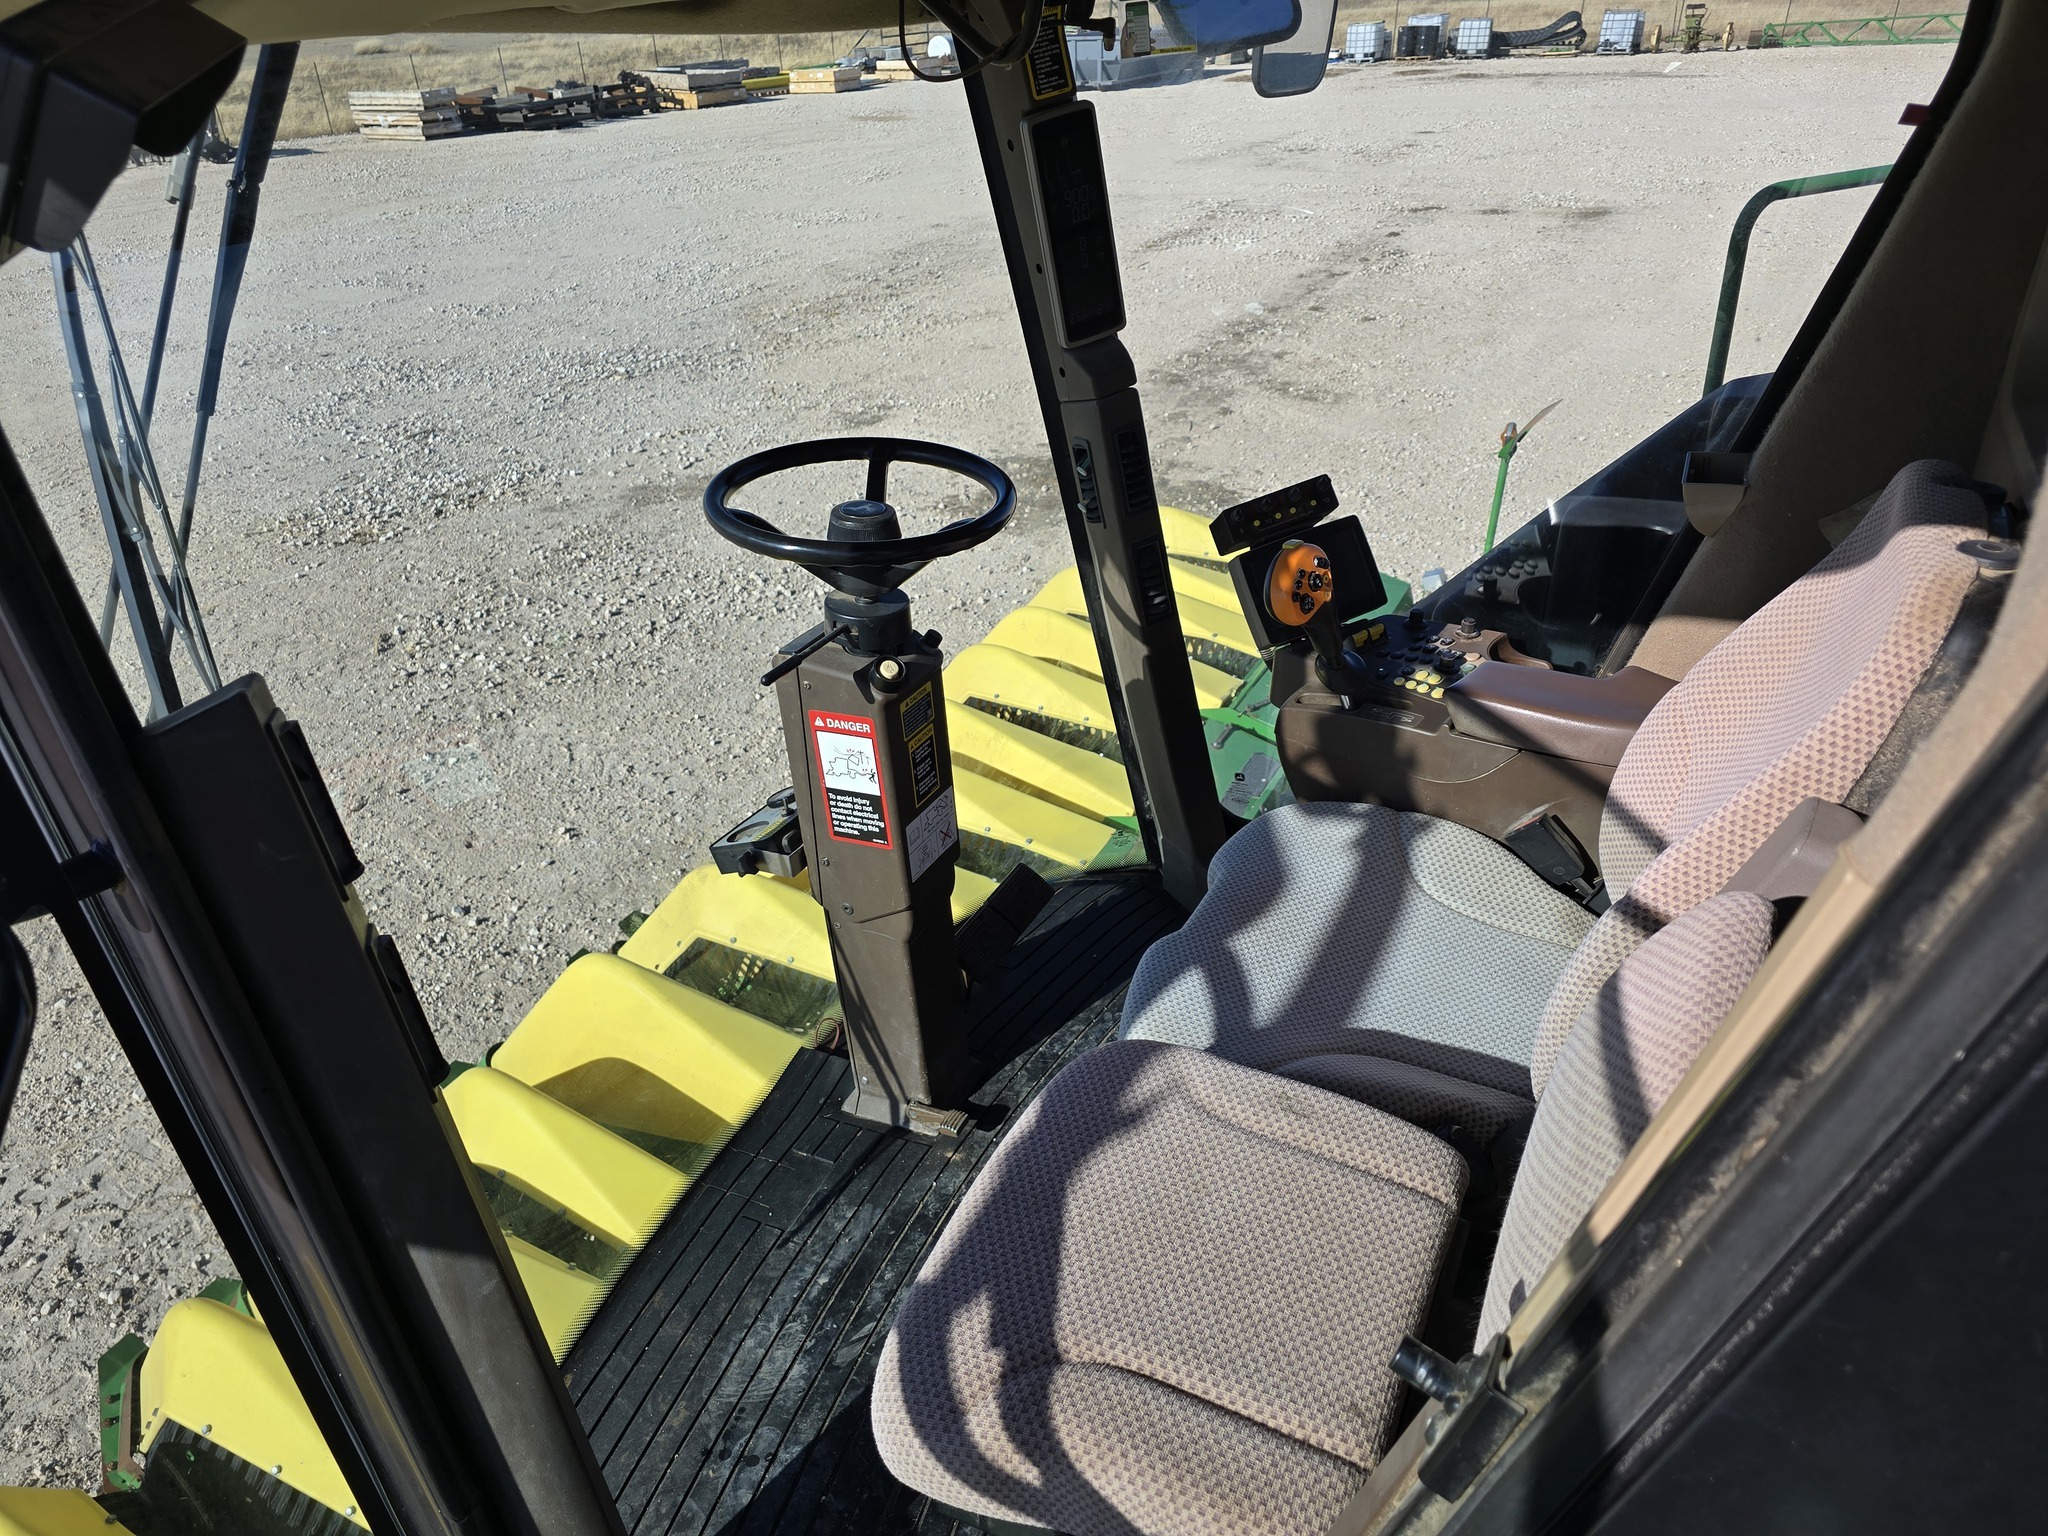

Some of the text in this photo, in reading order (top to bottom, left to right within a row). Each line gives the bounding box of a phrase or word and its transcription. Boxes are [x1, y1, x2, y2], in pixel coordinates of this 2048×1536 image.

[909, 686, 928, 704] CAUTION
[826, 718, 871, 734] DANGER
[914, 727, 933, 747] CAUTION
[837, 801, 853, 809] death
[853, 797, 870, 806] injury
[830, 807, 879, 819] contact electrical
[840, 821, 867, 831] operating
[863, 819, 885, 828] moving
[834, 827, 860, 835] machine.
